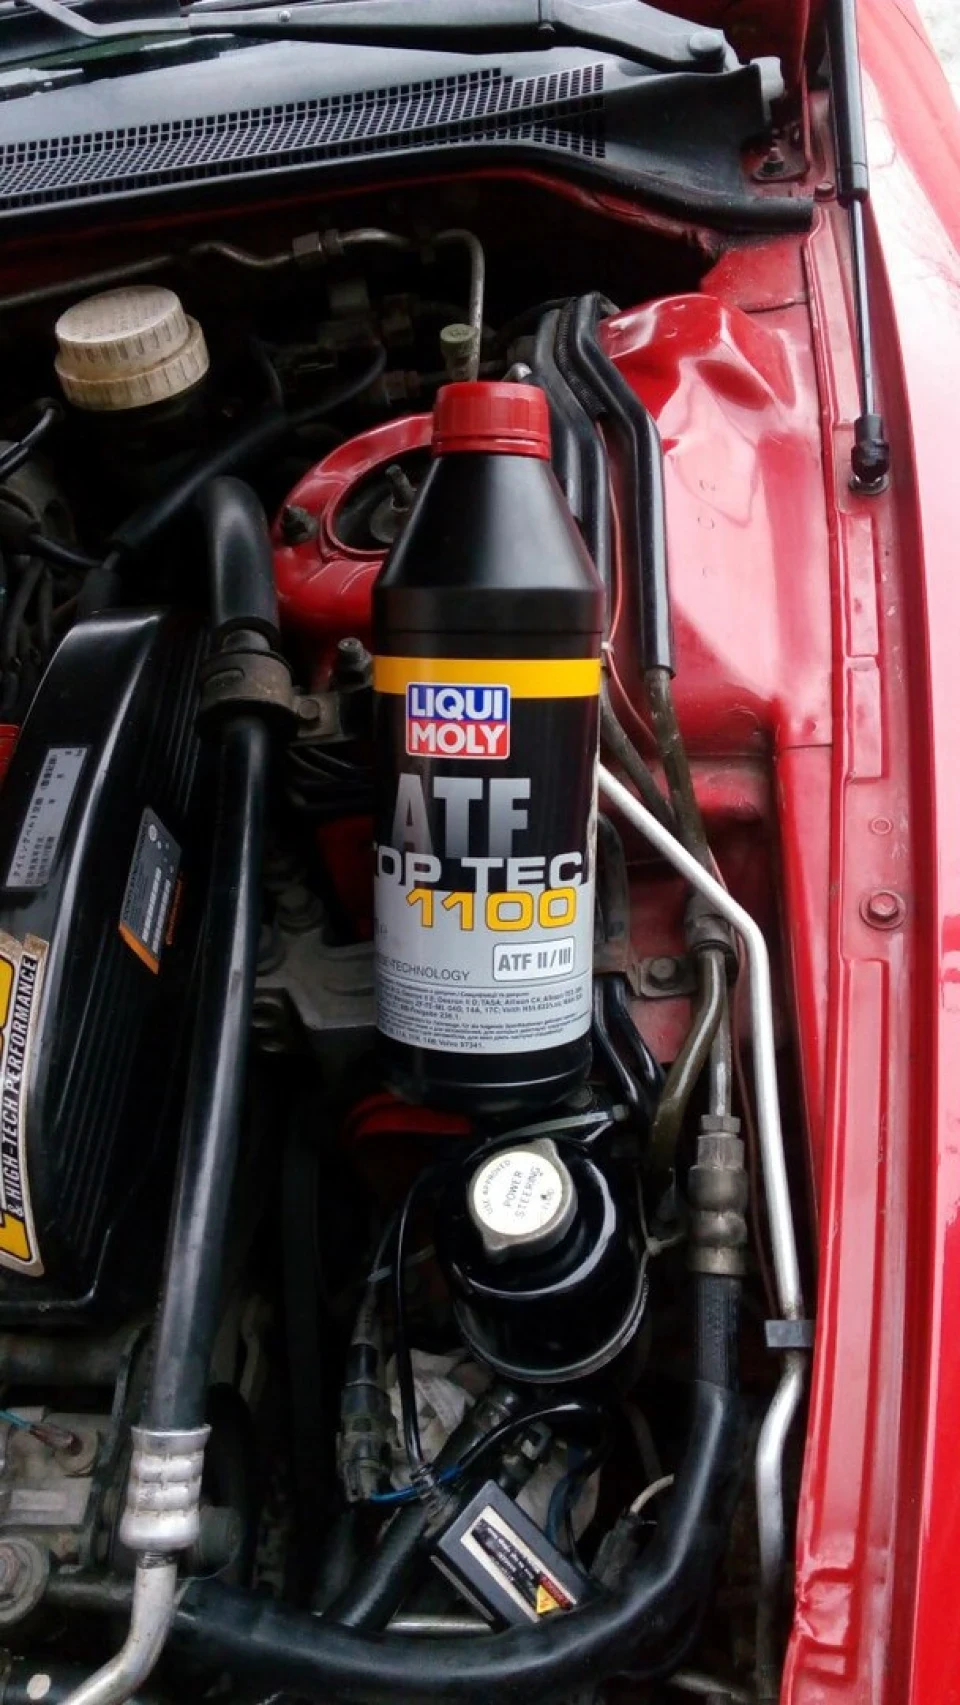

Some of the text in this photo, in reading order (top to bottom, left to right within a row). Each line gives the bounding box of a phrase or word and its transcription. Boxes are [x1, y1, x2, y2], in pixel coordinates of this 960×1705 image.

[411, 687, 503, 721] LIQUI
[411, 723, 506, 754] MOLY
[391, 772, 531, 859] ATF
[406, 887, 576, 931] 1100
[498, 954, 531, 971] ATF
[5, 953, 37, 1094] PERFORMANCE
[2, 1094, 23, 1200] HIGH-TECH
[502, 1171, 521, 1207] POWER
[514, 1165, 541, 1218] STEERING
[7, 1204, 23, 1217] &
